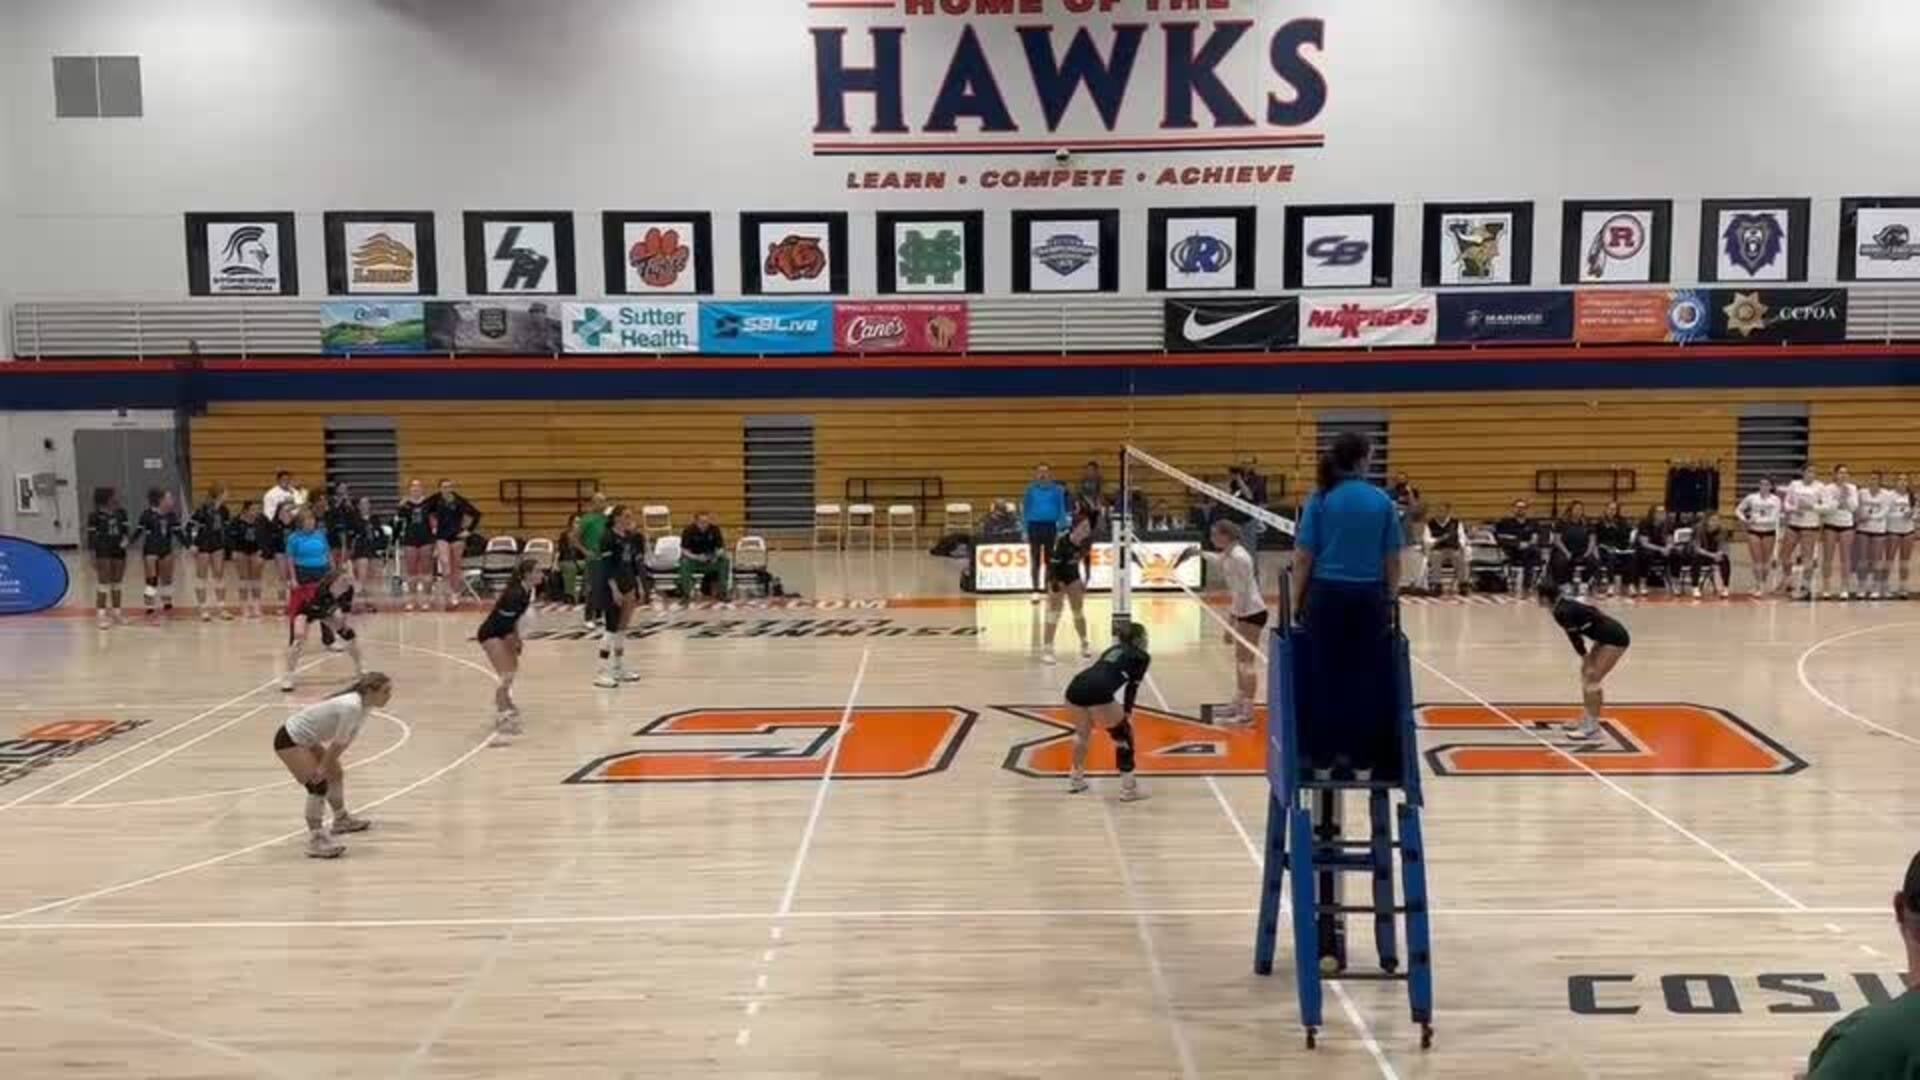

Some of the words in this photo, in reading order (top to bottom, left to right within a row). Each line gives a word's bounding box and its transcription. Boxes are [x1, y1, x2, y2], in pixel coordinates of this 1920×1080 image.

[809, 18, 1328, 133] HAWKS
[846, 171, 946, 189] LEARN
[979, 169, 1126, 188] COMPETE
[1156, 165, 1295, 187] ACHIEVE
[1609, 226, 1634, 247] R
[618, 306, 686, 326] Sutter
[620, 329, 690, 348] Health
